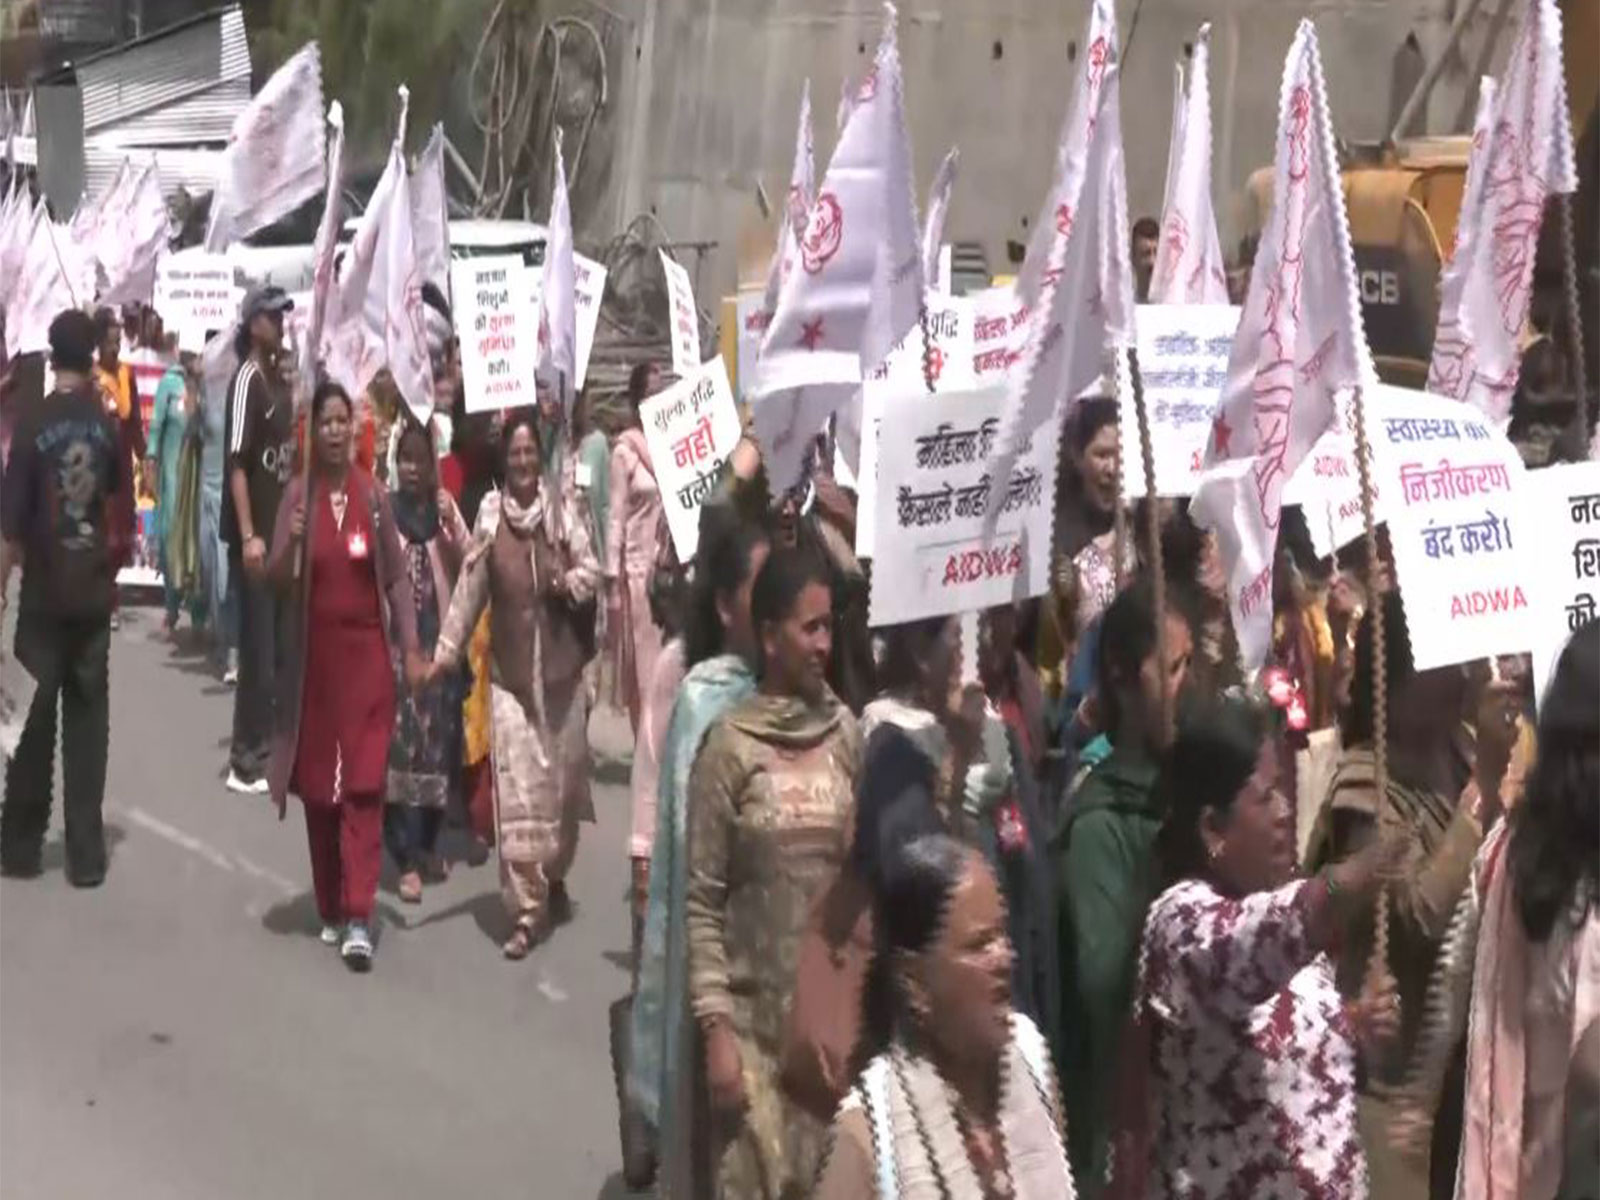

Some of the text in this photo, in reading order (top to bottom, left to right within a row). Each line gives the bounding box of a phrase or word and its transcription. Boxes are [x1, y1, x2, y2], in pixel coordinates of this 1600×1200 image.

[1360, 270, 1400, 304] CB
[671, 411, 717, 468] नहीं
[1399, 458, 1511, 505] निजीकरण
[1421, 510, 1513, 559] बंद करो।
[942, 544, 1024, 587] AIDWA
[1451, 586, 1528, 620] AIDWA
